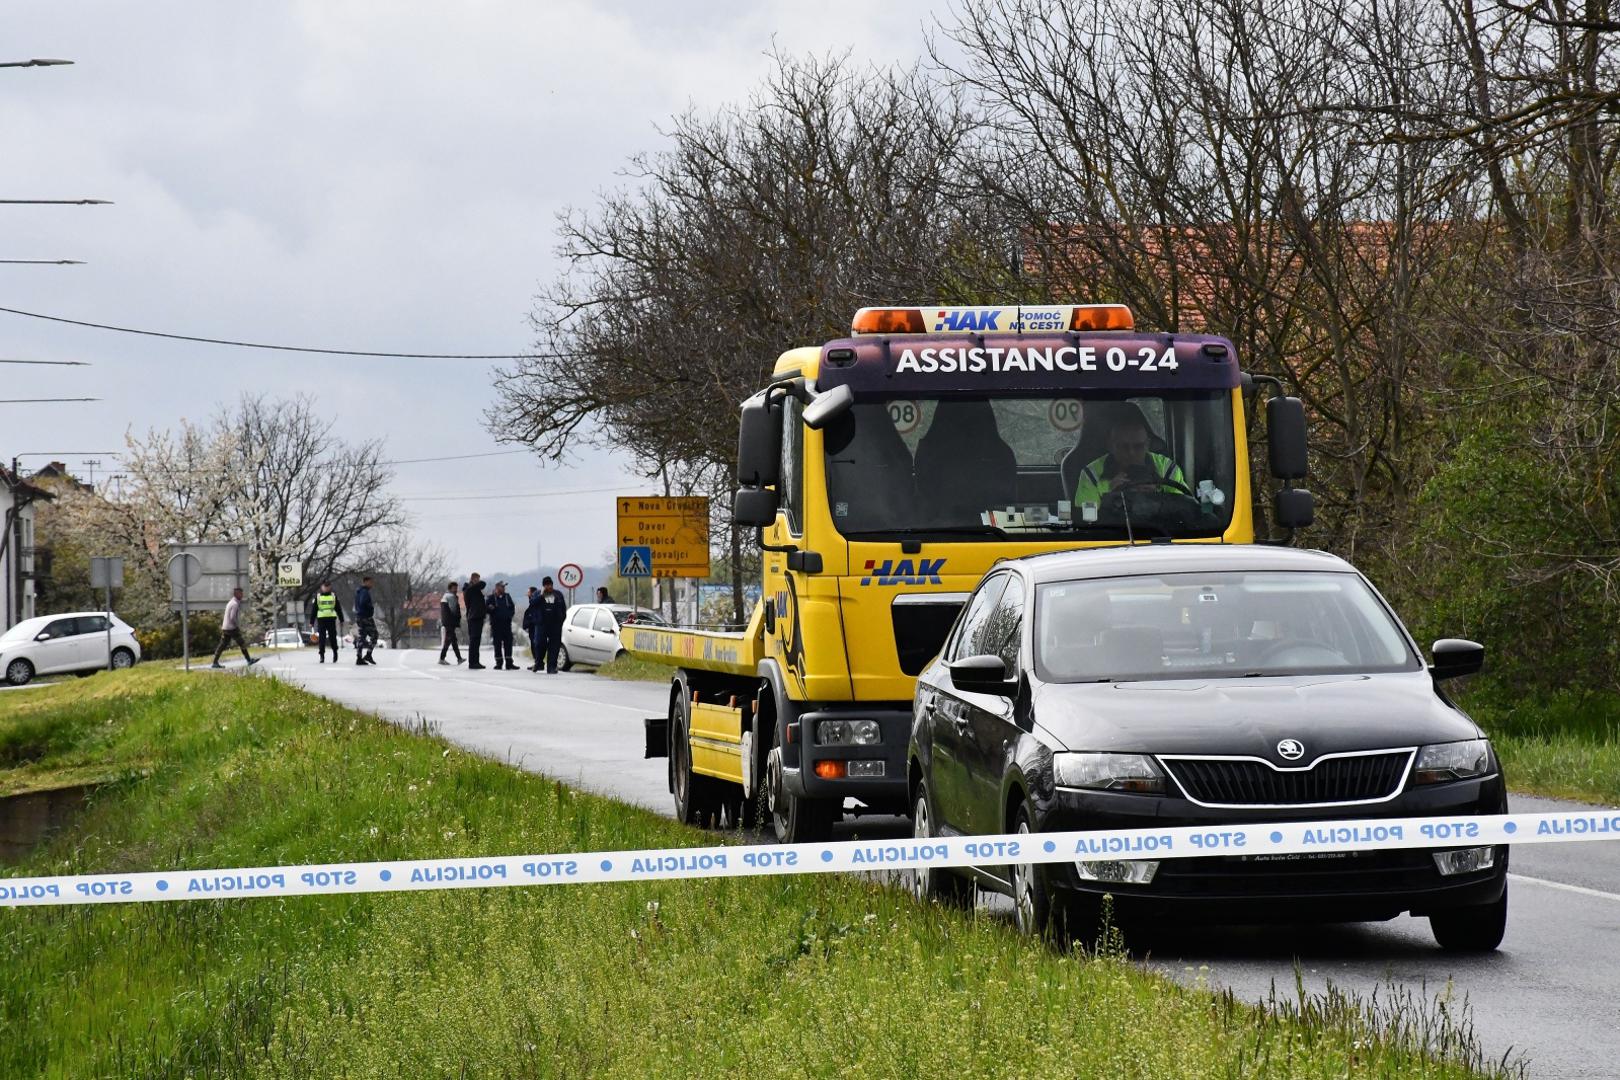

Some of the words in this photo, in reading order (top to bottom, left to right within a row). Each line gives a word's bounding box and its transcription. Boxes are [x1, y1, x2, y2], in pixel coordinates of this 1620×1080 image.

[935, 310, 1001, 331] HAK
[1017, 310, 1061, 320] POMOĆ
[1009, 322, 1025, 330] NA
[1030, 321, 1064, 330] CESTI
[896, 347, 1096, 373] ASSISTANCE
[1106, 348, 1179, 372] 0-24
[639, 502, 660, 510] Nova
[860, 558, 947, 586] HAK
